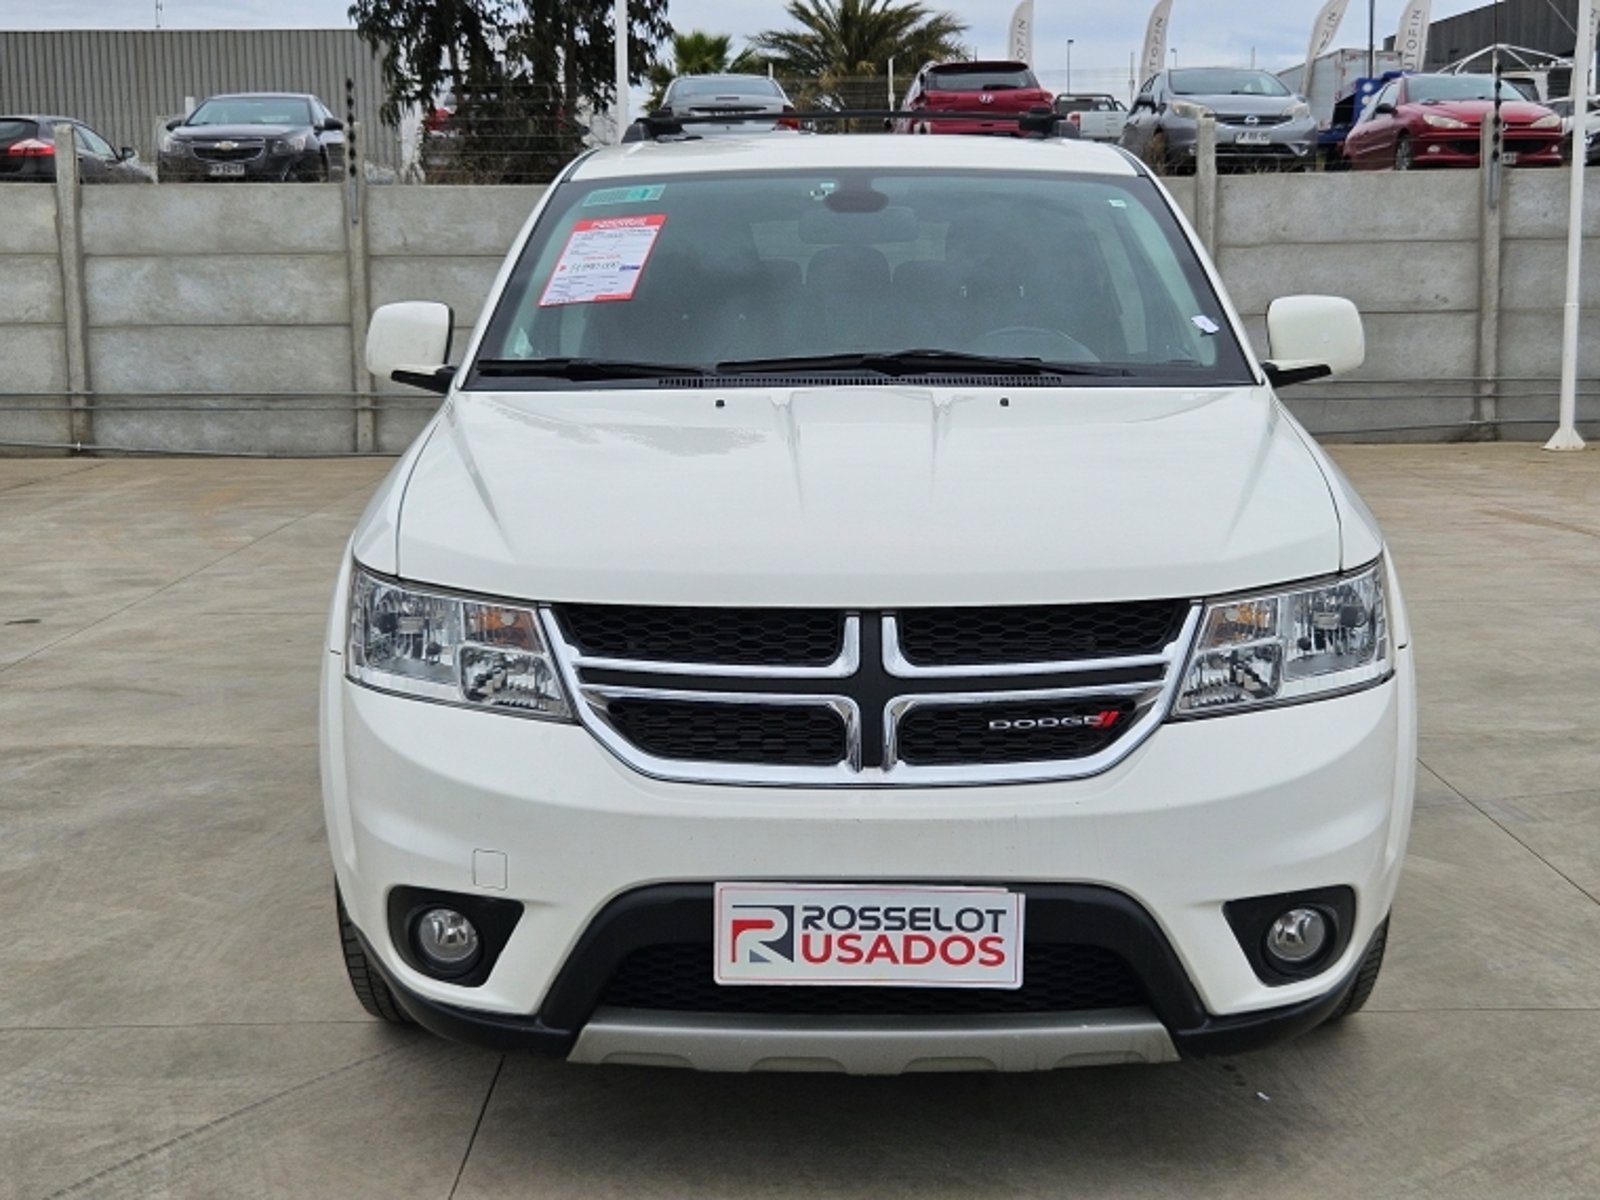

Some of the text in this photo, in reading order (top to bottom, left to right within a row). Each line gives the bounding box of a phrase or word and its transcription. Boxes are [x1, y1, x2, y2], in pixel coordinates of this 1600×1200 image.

[1016, 18, 1027, 60] OFIN
[1404, 9, 1421, 70] UTOFIN
[988, 715, 1102, 730] DODGE
[802, 905, 1007, 933] ROSSELOT
[801, 934, 1006, 966] USADOS
